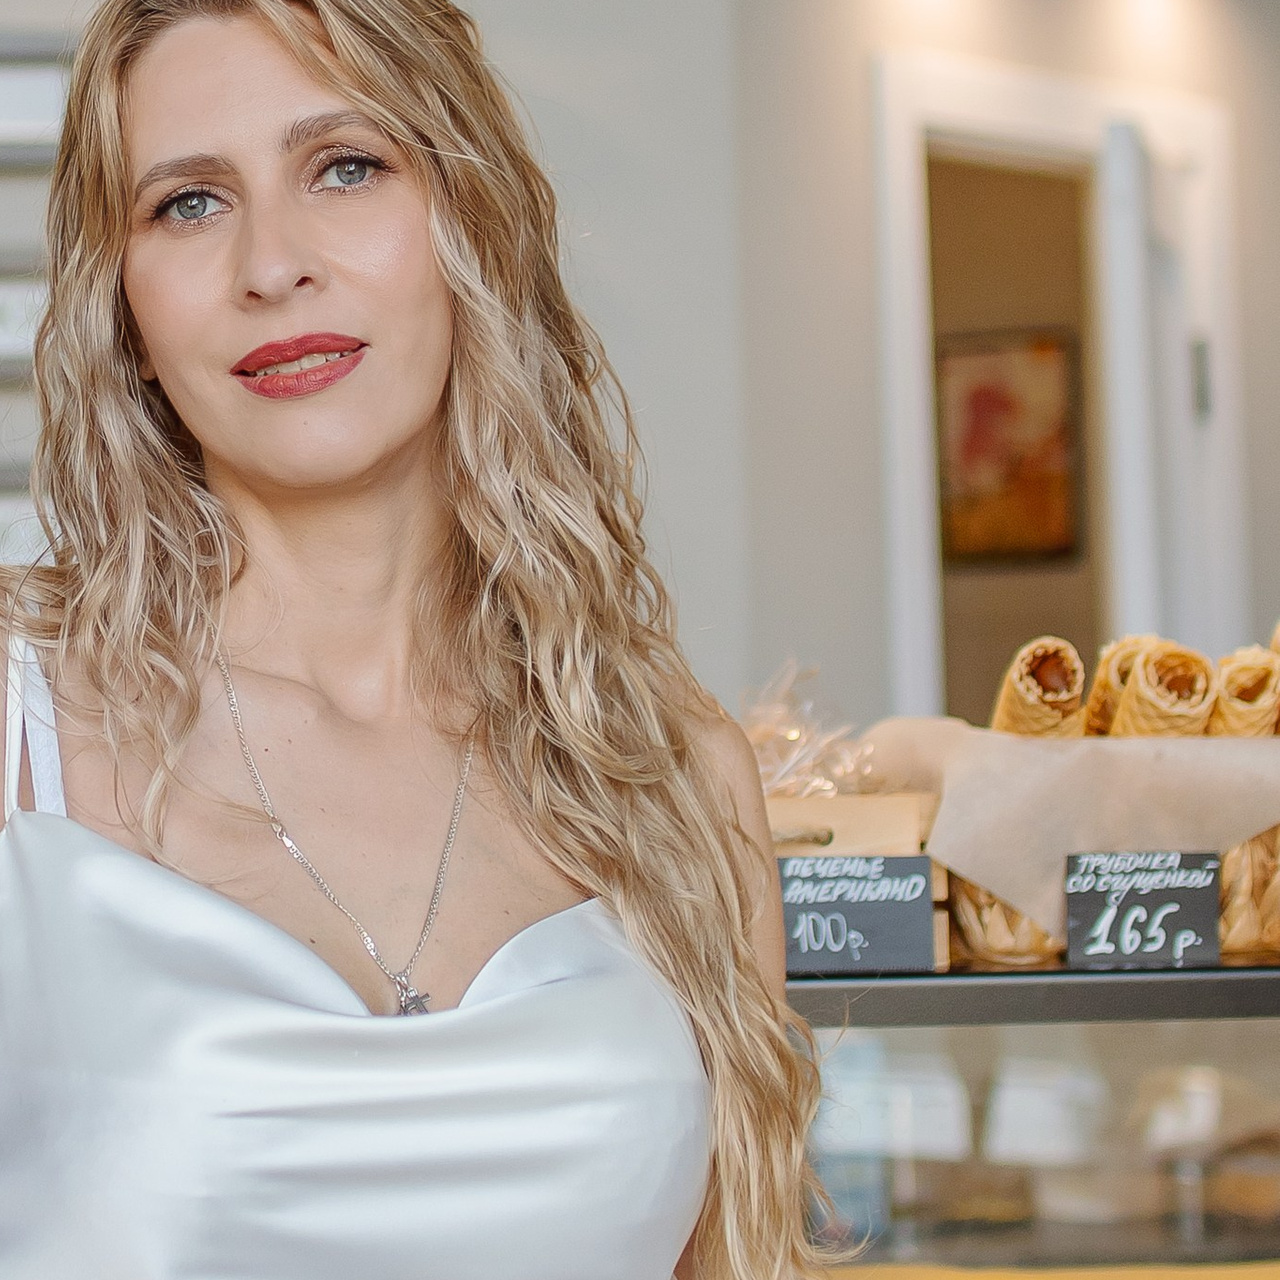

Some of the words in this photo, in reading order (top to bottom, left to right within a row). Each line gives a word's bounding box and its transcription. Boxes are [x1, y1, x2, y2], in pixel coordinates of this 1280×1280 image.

[785, 857, 884, 879] ПЕЧЕНЬЕ
[1078, 853, 1181, 873] ТРУБОЧКА
[784, 874, 926, 903] АМЕРИКАНО
[1067, 873, 1096, 893] СО
[1084, 902, 1180, 955] 165
